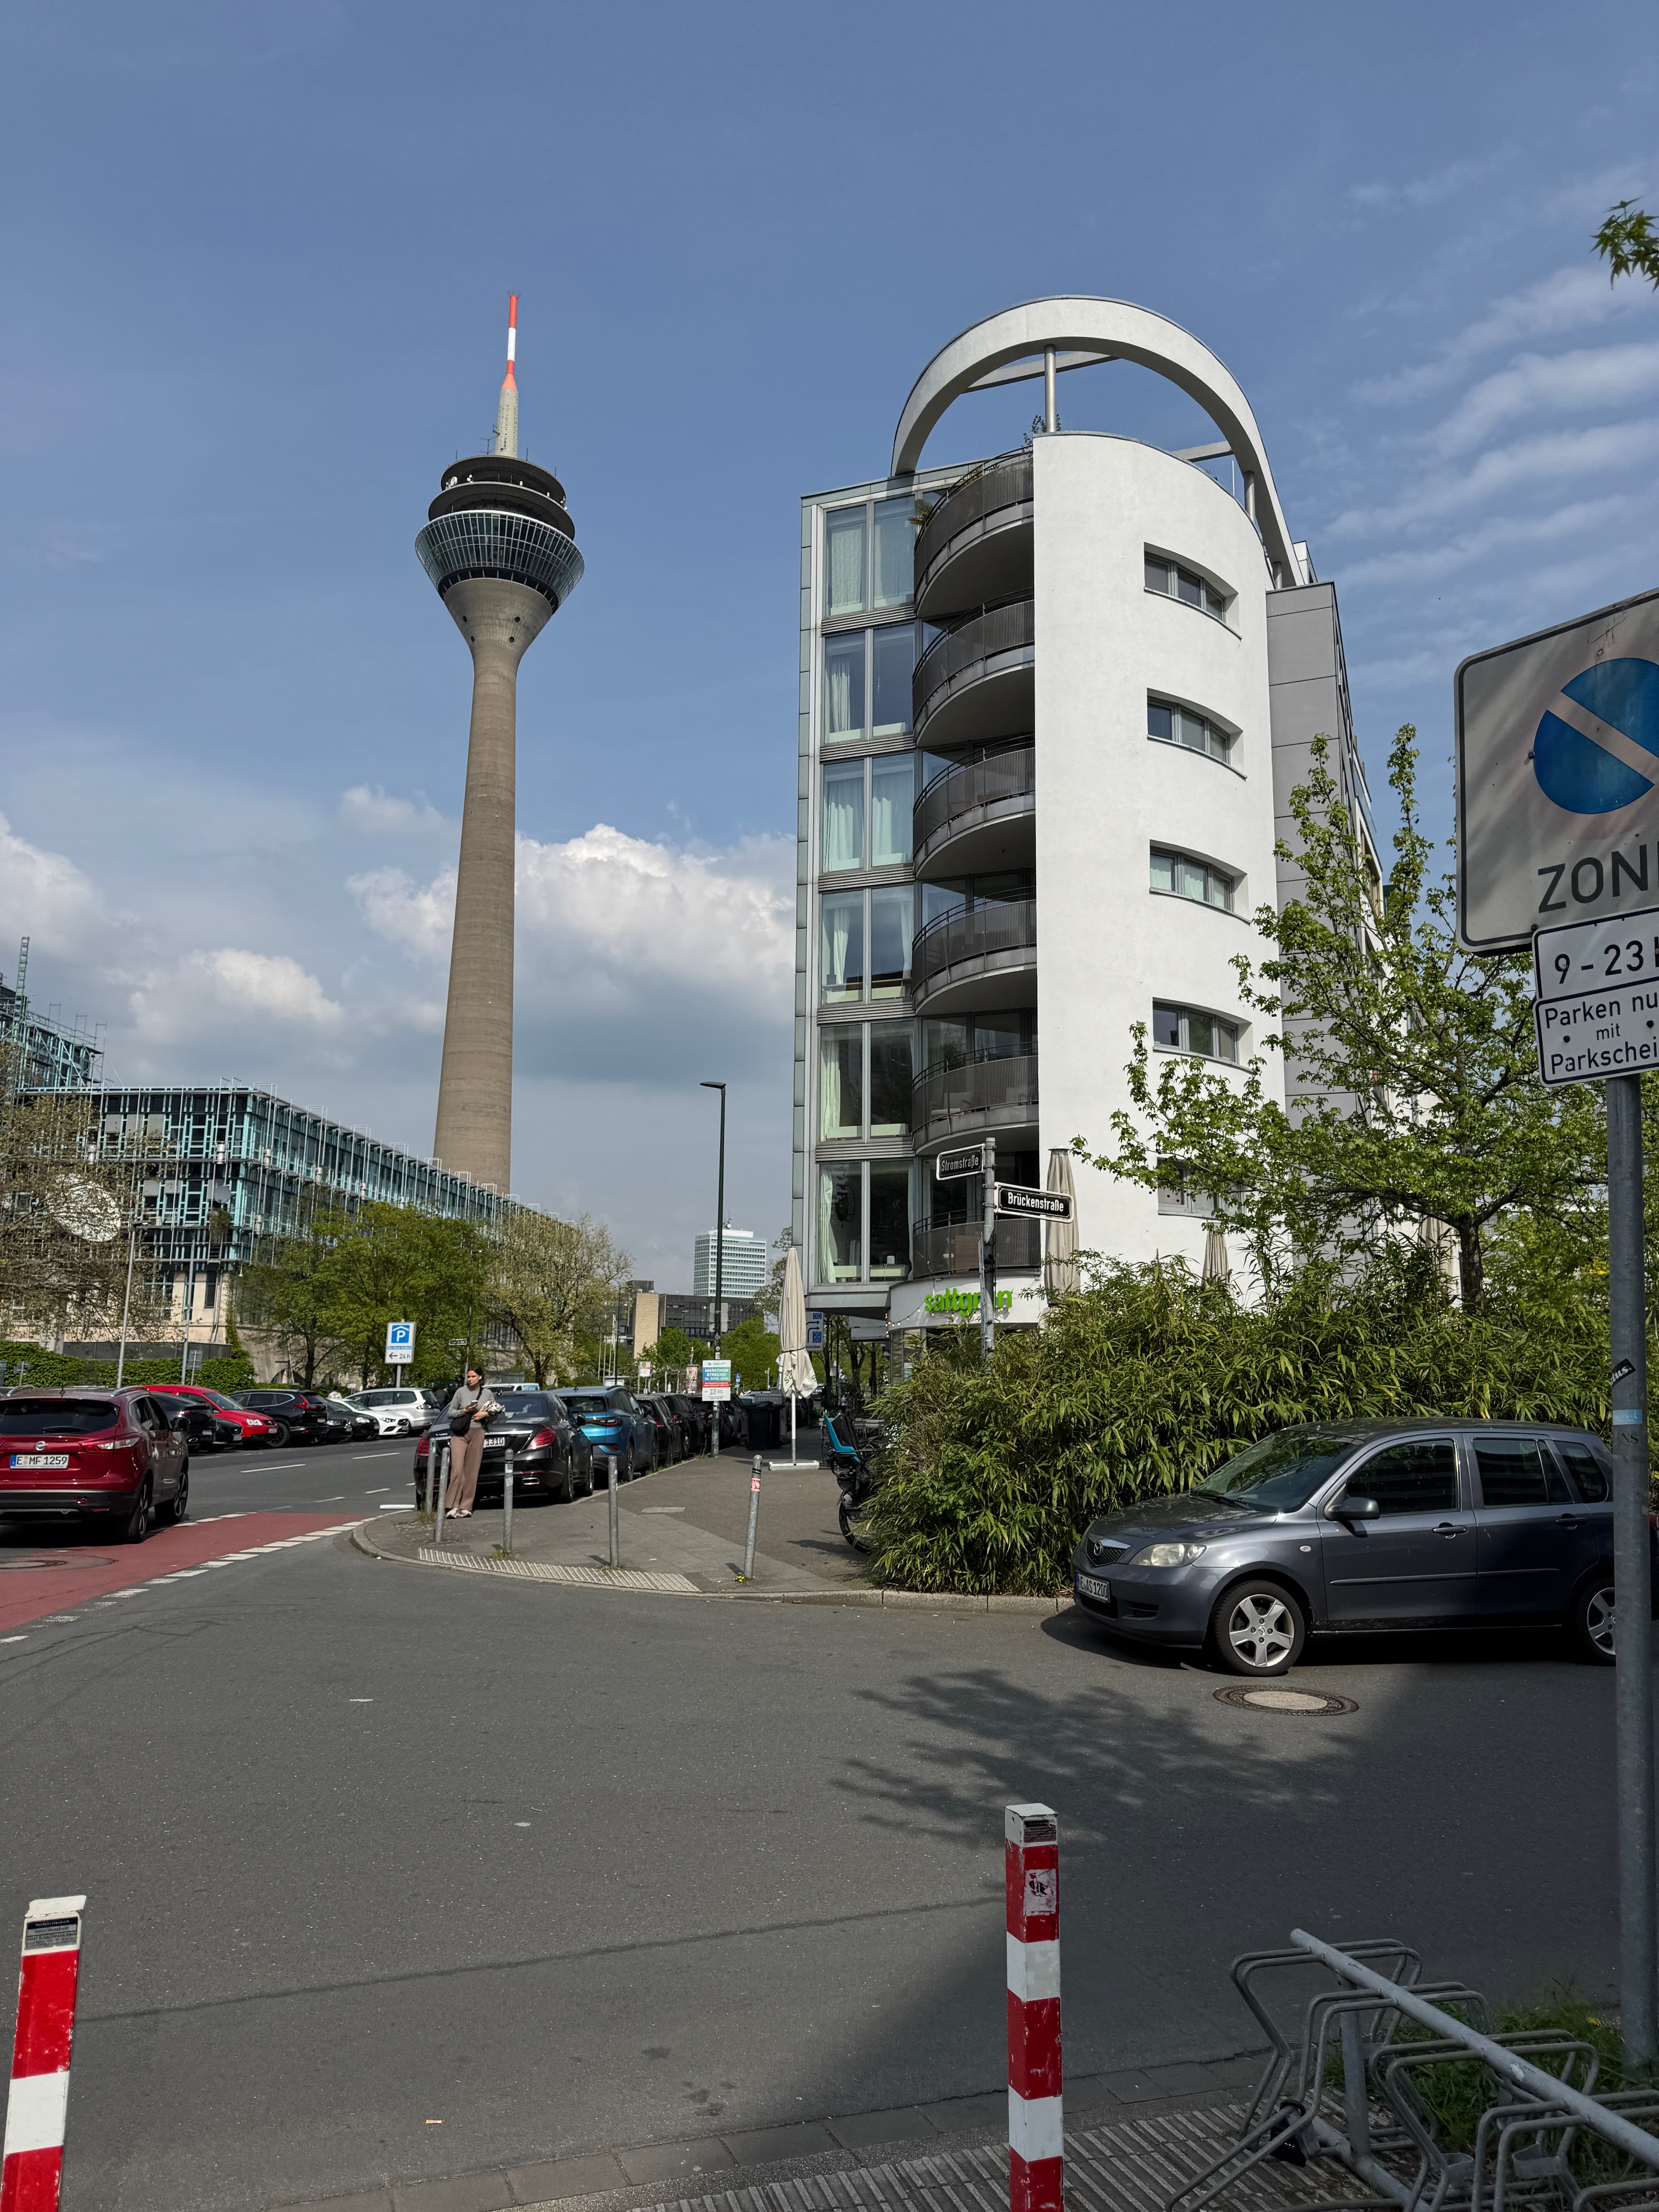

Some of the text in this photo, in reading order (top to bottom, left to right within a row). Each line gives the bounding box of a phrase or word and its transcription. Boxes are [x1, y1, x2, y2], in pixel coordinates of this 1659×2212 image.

[1538, 841, 1659, 913] ZON
[1545, 1001, 1621, 1029] Parken
[1596, 1023, 1621, 1040] mit
[1551, 1036, 1658, 1074] Parkschei
[941, 1154, 979, 1172] Stromstraße
[1007, 1192, 1064, 1212] Brückenstraße
[924, 1287, 1012, 1317] sattgrn
[396, 1330, 406, 1342] P
[486, 1438, 504, 1446] 1310
[16, 1456, 67, 1465] E MF 1259
[1086, 1579, 1093, 1593] AS
